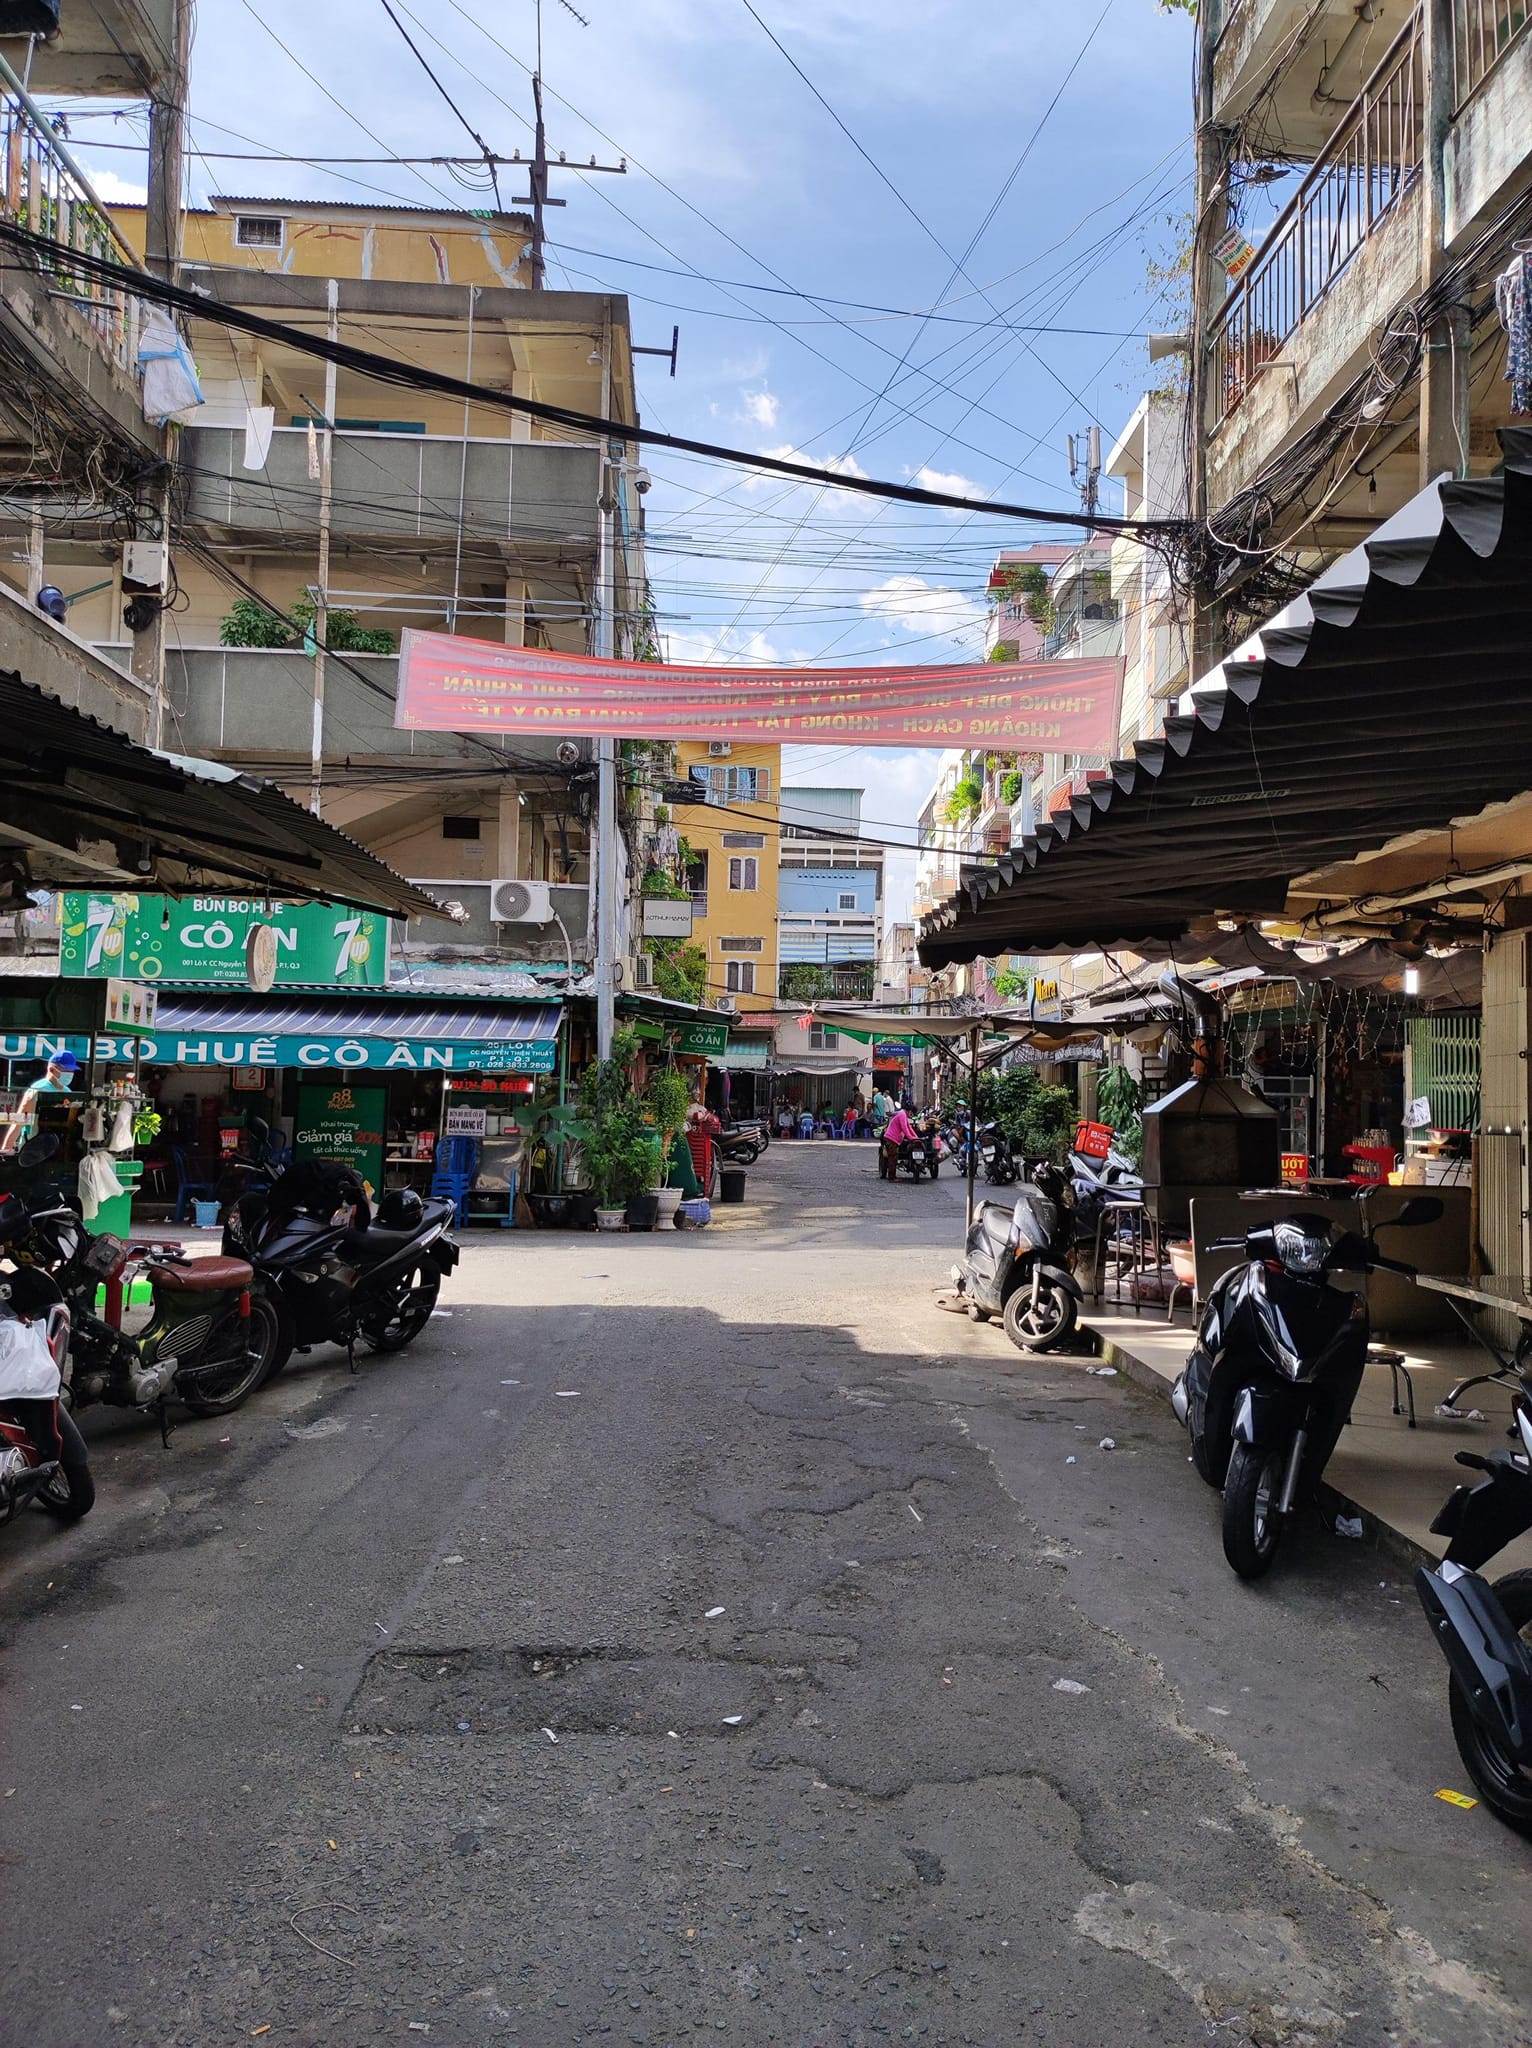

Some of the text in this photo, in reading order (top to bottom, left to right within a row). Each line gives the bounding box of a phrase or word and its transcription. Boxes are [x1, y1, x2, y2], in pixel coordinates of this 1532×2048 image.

[193, 897, 225, 913] BÚN
[180, 920, 234, 949] CÔ
[689, 1032, 704, 1044] CÔ
[177, 1036, 278, 1064] HUẾ
[297, 1040, 370, 1067] CÔ
[385, 1040, 454, 1068] ÂN
[296, 1129, 333, 1144] Giảm
[333, 1129, 353, 1146] giá
